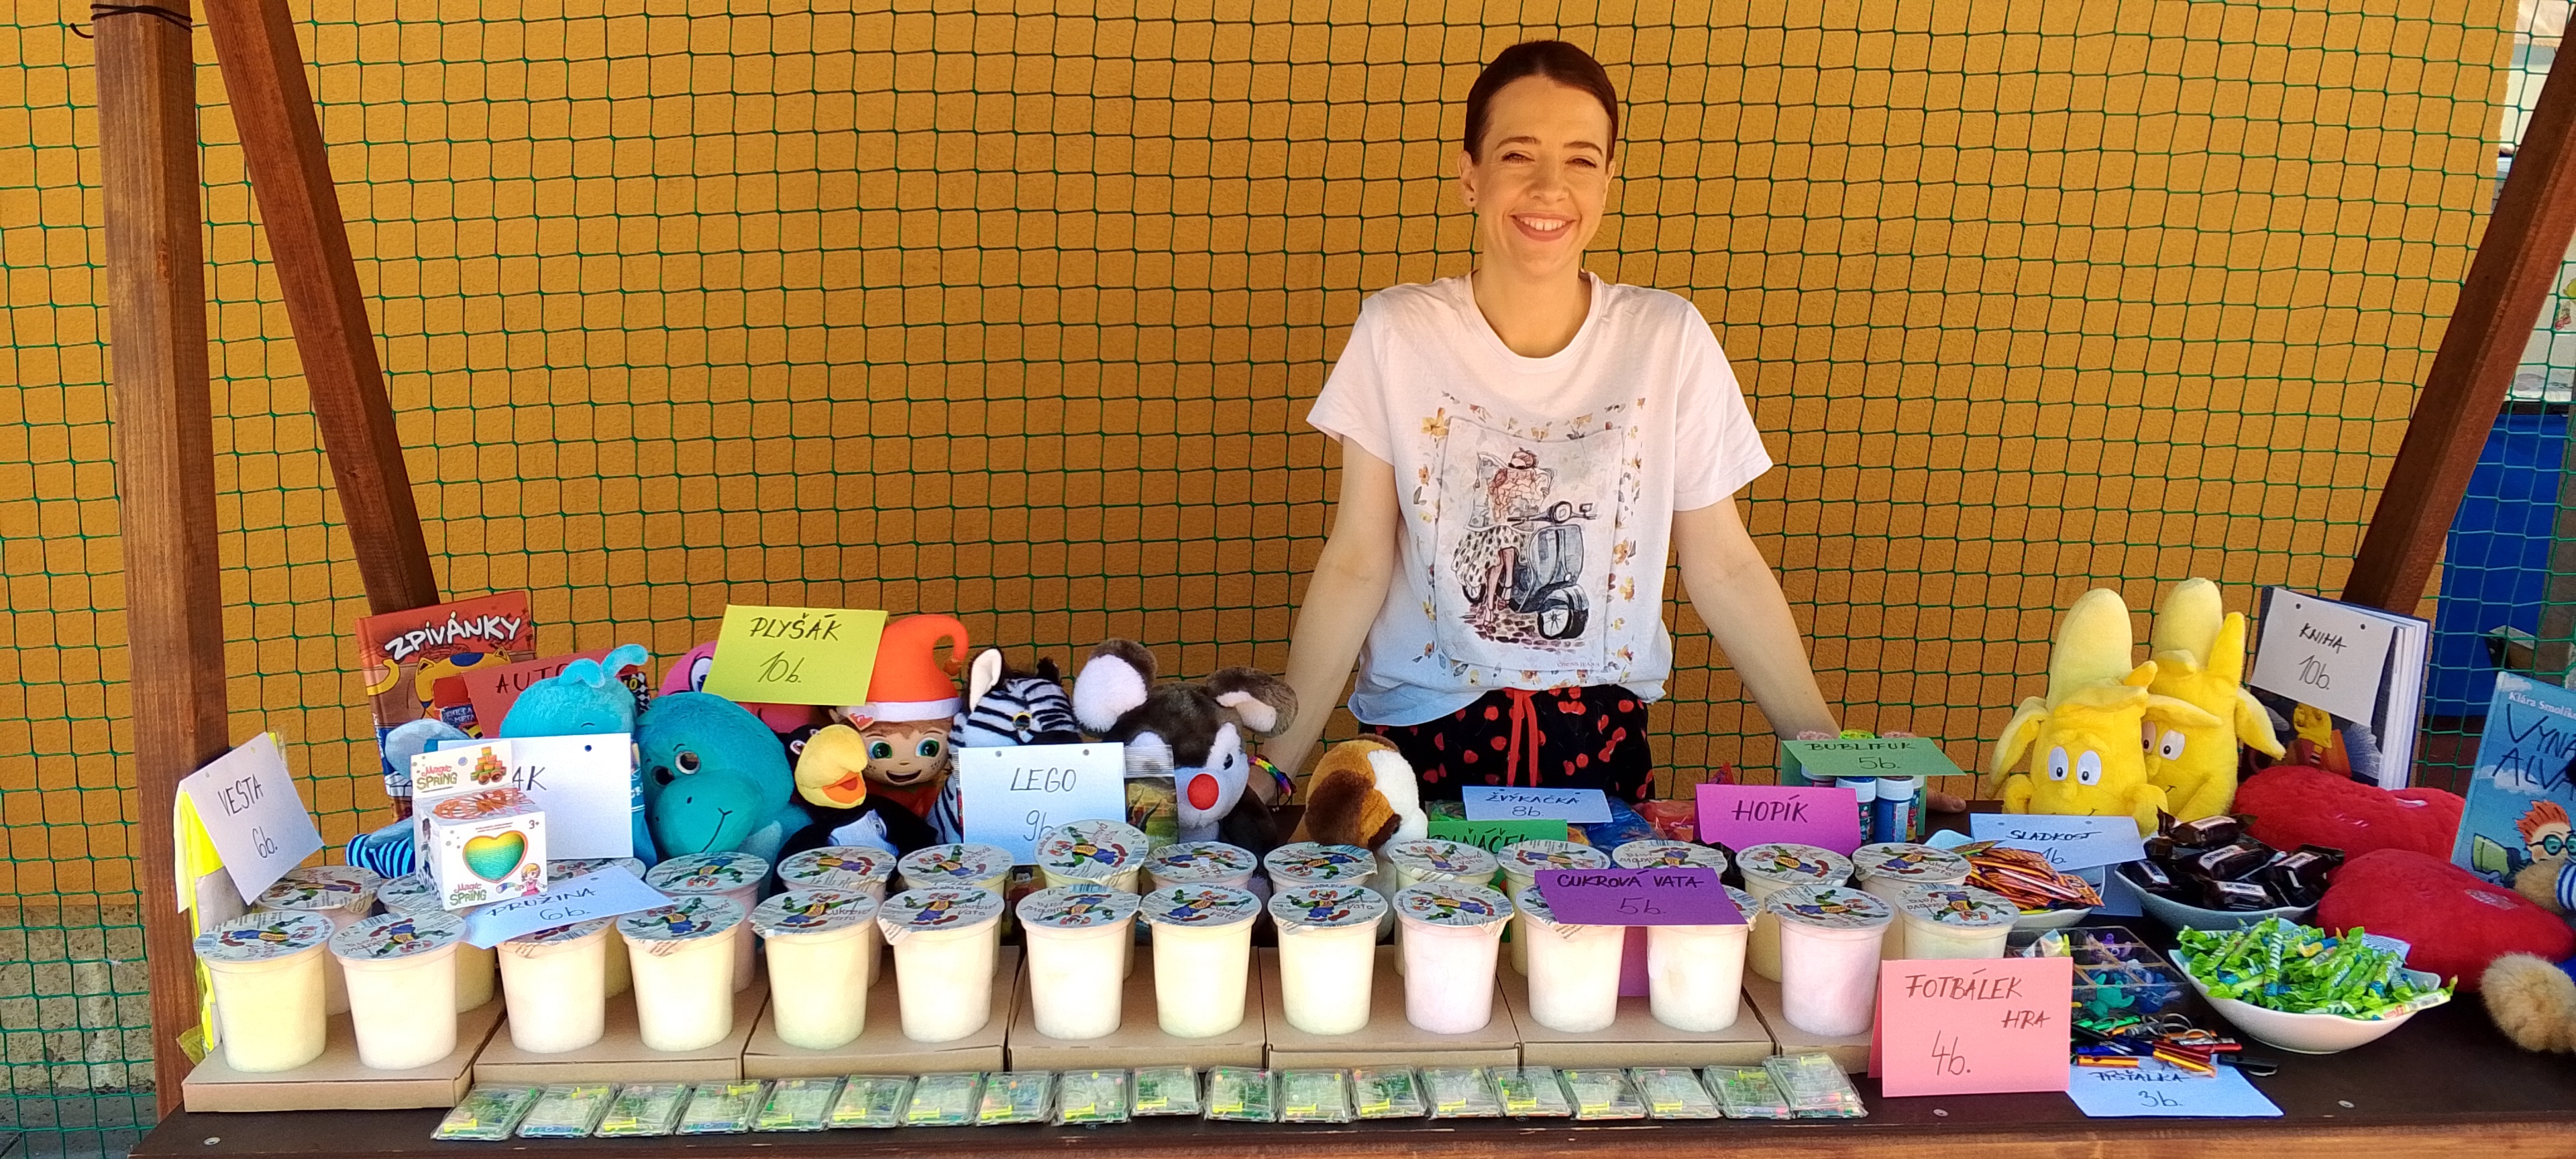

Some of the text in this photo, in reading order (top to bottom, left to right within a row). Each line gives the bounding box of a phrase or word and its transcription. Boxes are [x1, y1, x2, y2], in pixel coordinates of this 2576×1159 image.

[384, 611, 521, 661] ZPÍVÁNKY
[749, 612, 843, 641] PLYŠÁK
[2299, 622, 2347, 654] KNIHA
[2508, 691, 2536, 707] Klára
[421, 765, 452, 777] Magic
[1858, 757, 1901, 769] 5b.
[1010, 767, 1077, 793] LEGO
[217, 773, 264, 817] VESTA
[1512, 806, 1544, 817] 8b.
[1731, 794, 1810, 824] HOPÍK
[2006, 830, 2102, 841] SLADKOST
[453, 882, 482, 893] Magic
[1556, 870, 1705, 889] CUKROVÁ VATA
[485, 887, 596, 916] PRUŽINA
[1616, 897, 1667, 915] 5b.
[1905, 968, 2024, 1000] FOTBÁLEK
[2002, 1010, 2051, 1030] HRA
[1931, 1030, 1971, 1077] 4b.
